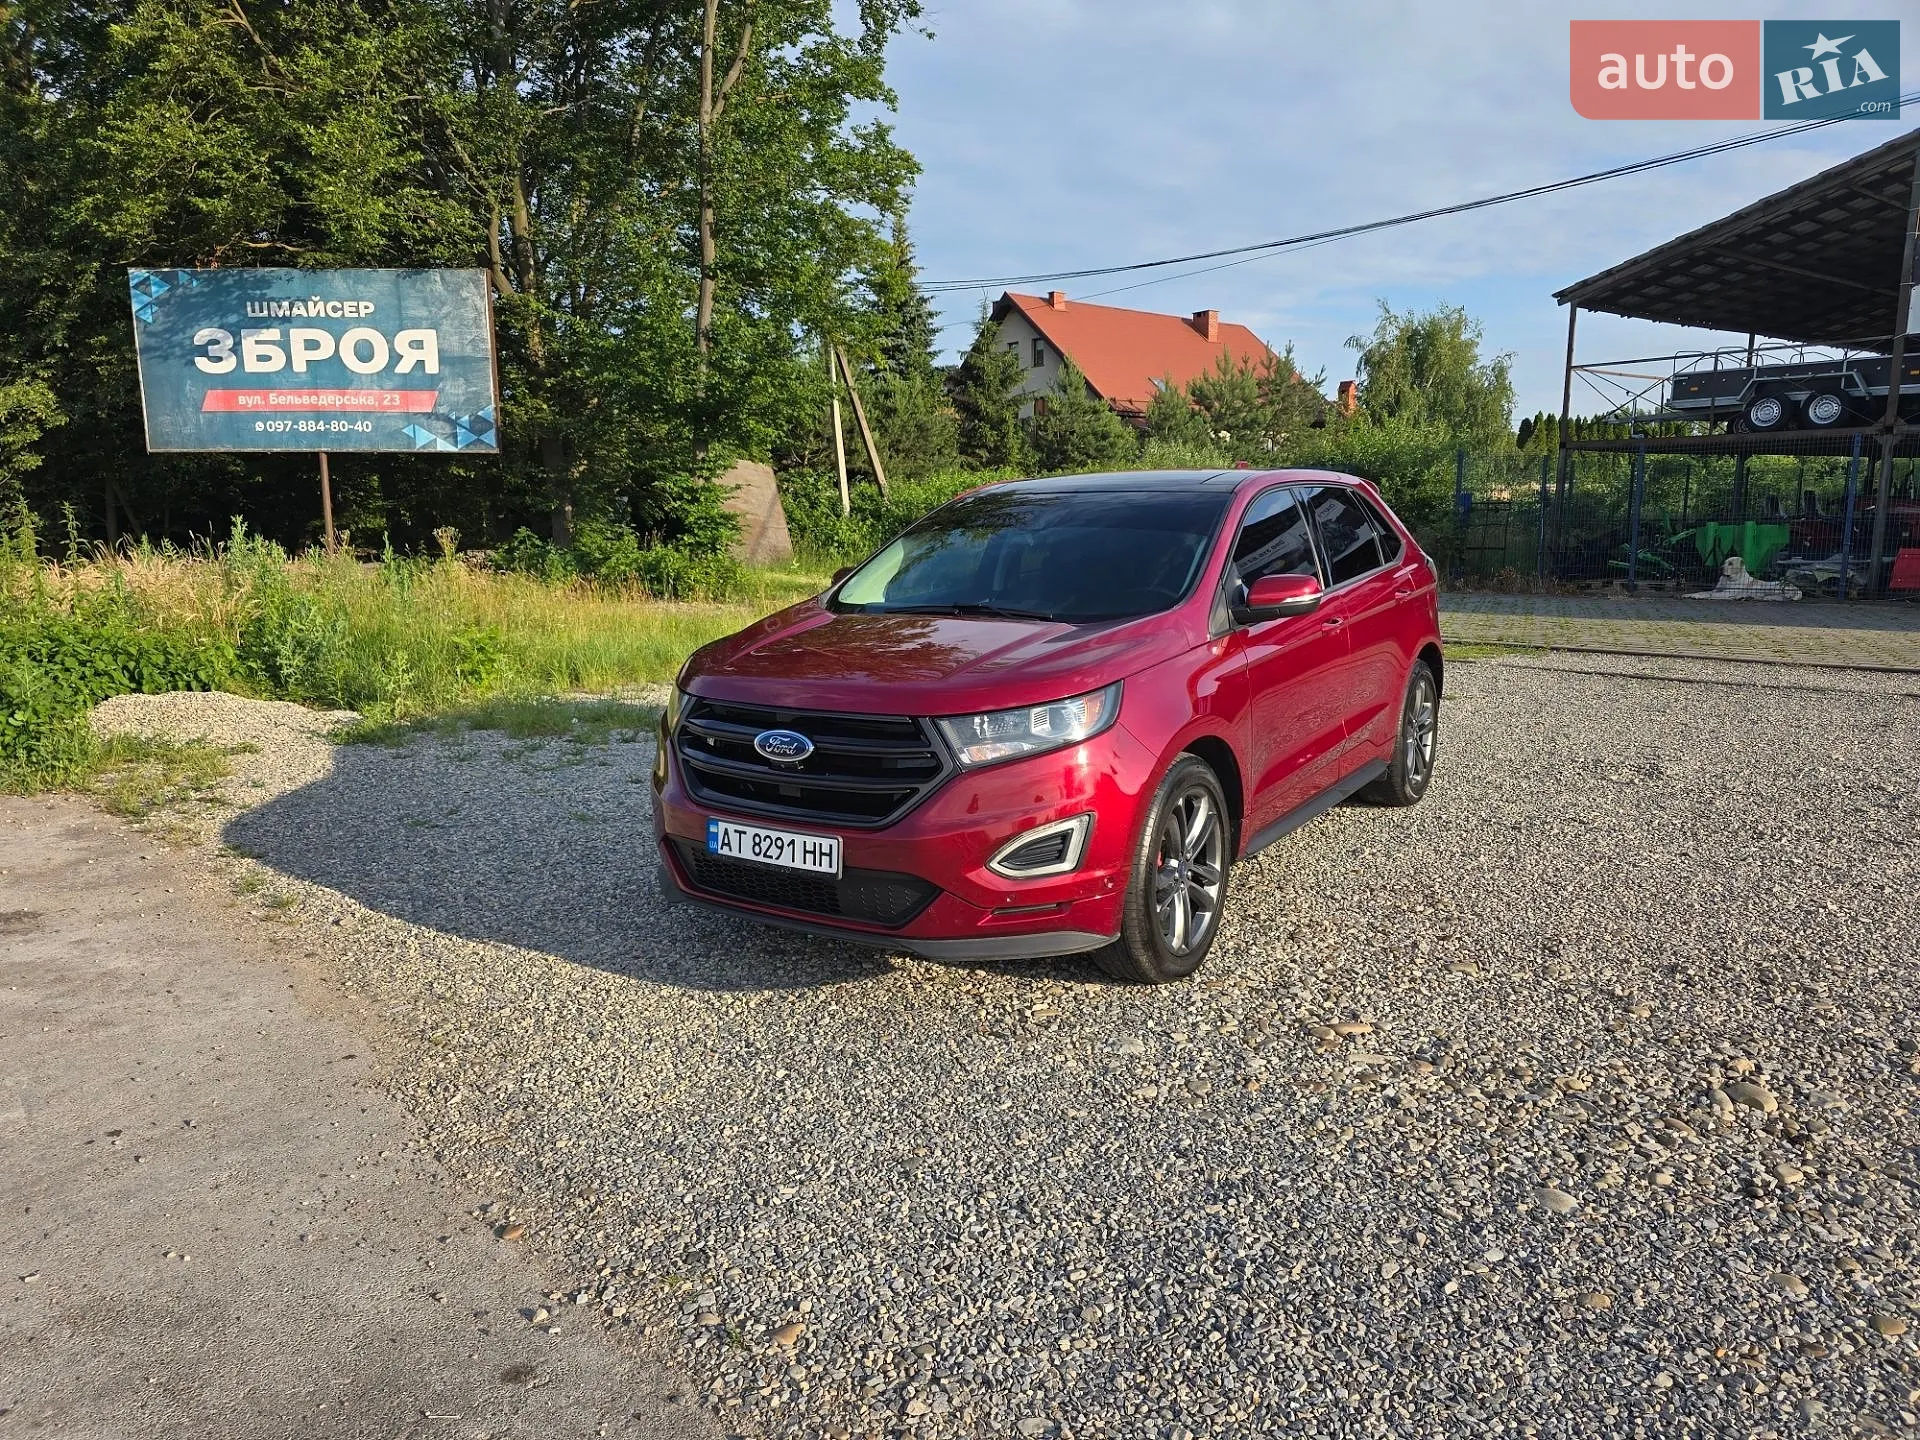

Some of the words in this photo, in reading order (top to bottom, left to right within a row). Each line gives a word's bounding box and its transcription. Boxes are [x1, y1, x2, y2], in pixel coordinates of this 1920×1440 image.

[246, 296, 375, 318] ШМАЙСЕР
[192, 327, 440, 375] ЗБРОЯ
[238, 395, 266, 408] вул.
[269, 393, 379, 407] Бельведерська,
[383, 394, 400, 406] 23
[266, 420, 372, 433] 097-884-80-40
[765, 735, 798, 755] Ford
[709, 841, 717, 849] UA
[720, 827, 747, 854] AT
[752, 833, 796, 863] 8291
[802, 840, 833, 869] HH
